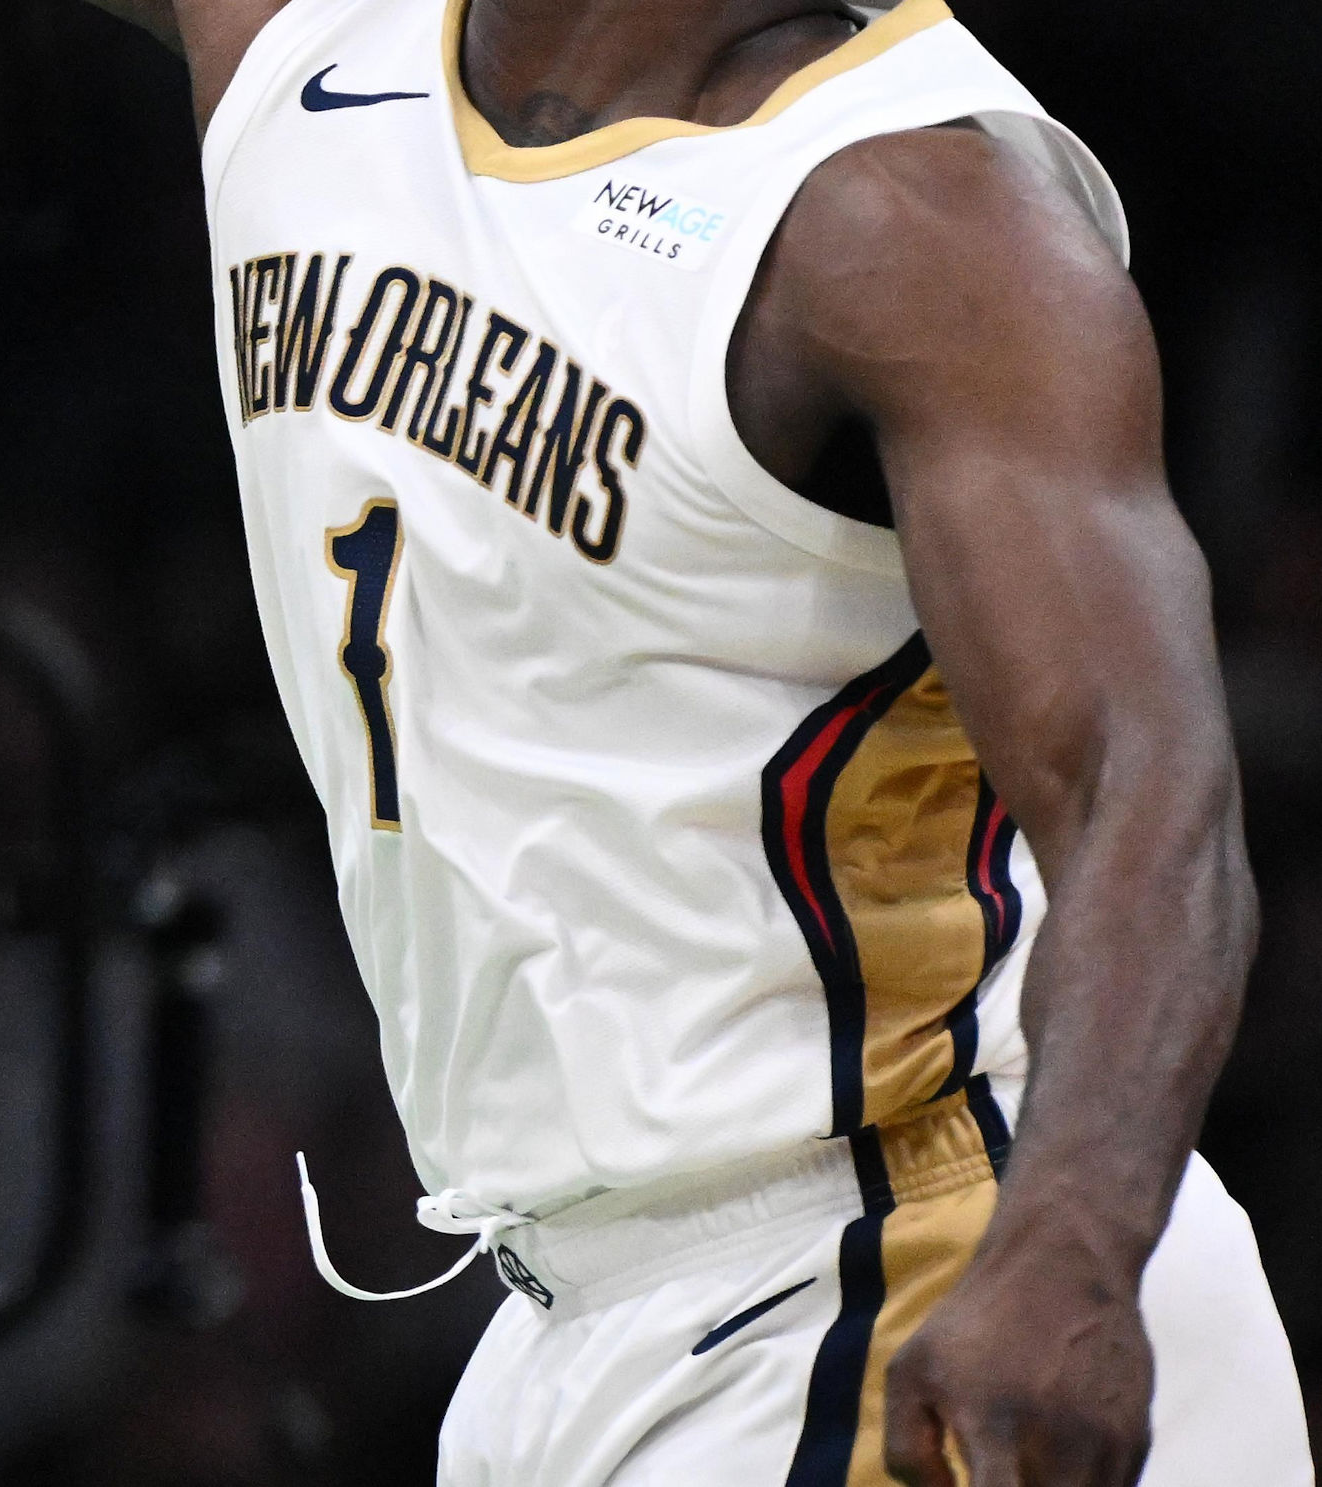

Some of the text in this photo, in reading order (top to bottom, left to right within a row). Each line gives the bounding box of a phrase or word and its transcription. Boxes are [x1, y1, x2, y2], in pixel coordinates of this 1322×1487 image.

[598, 218, 682, 259] GRILLS
[228, 250, 650, 566] NEW ORLEANS
[324, 496, 406, 833] 1
